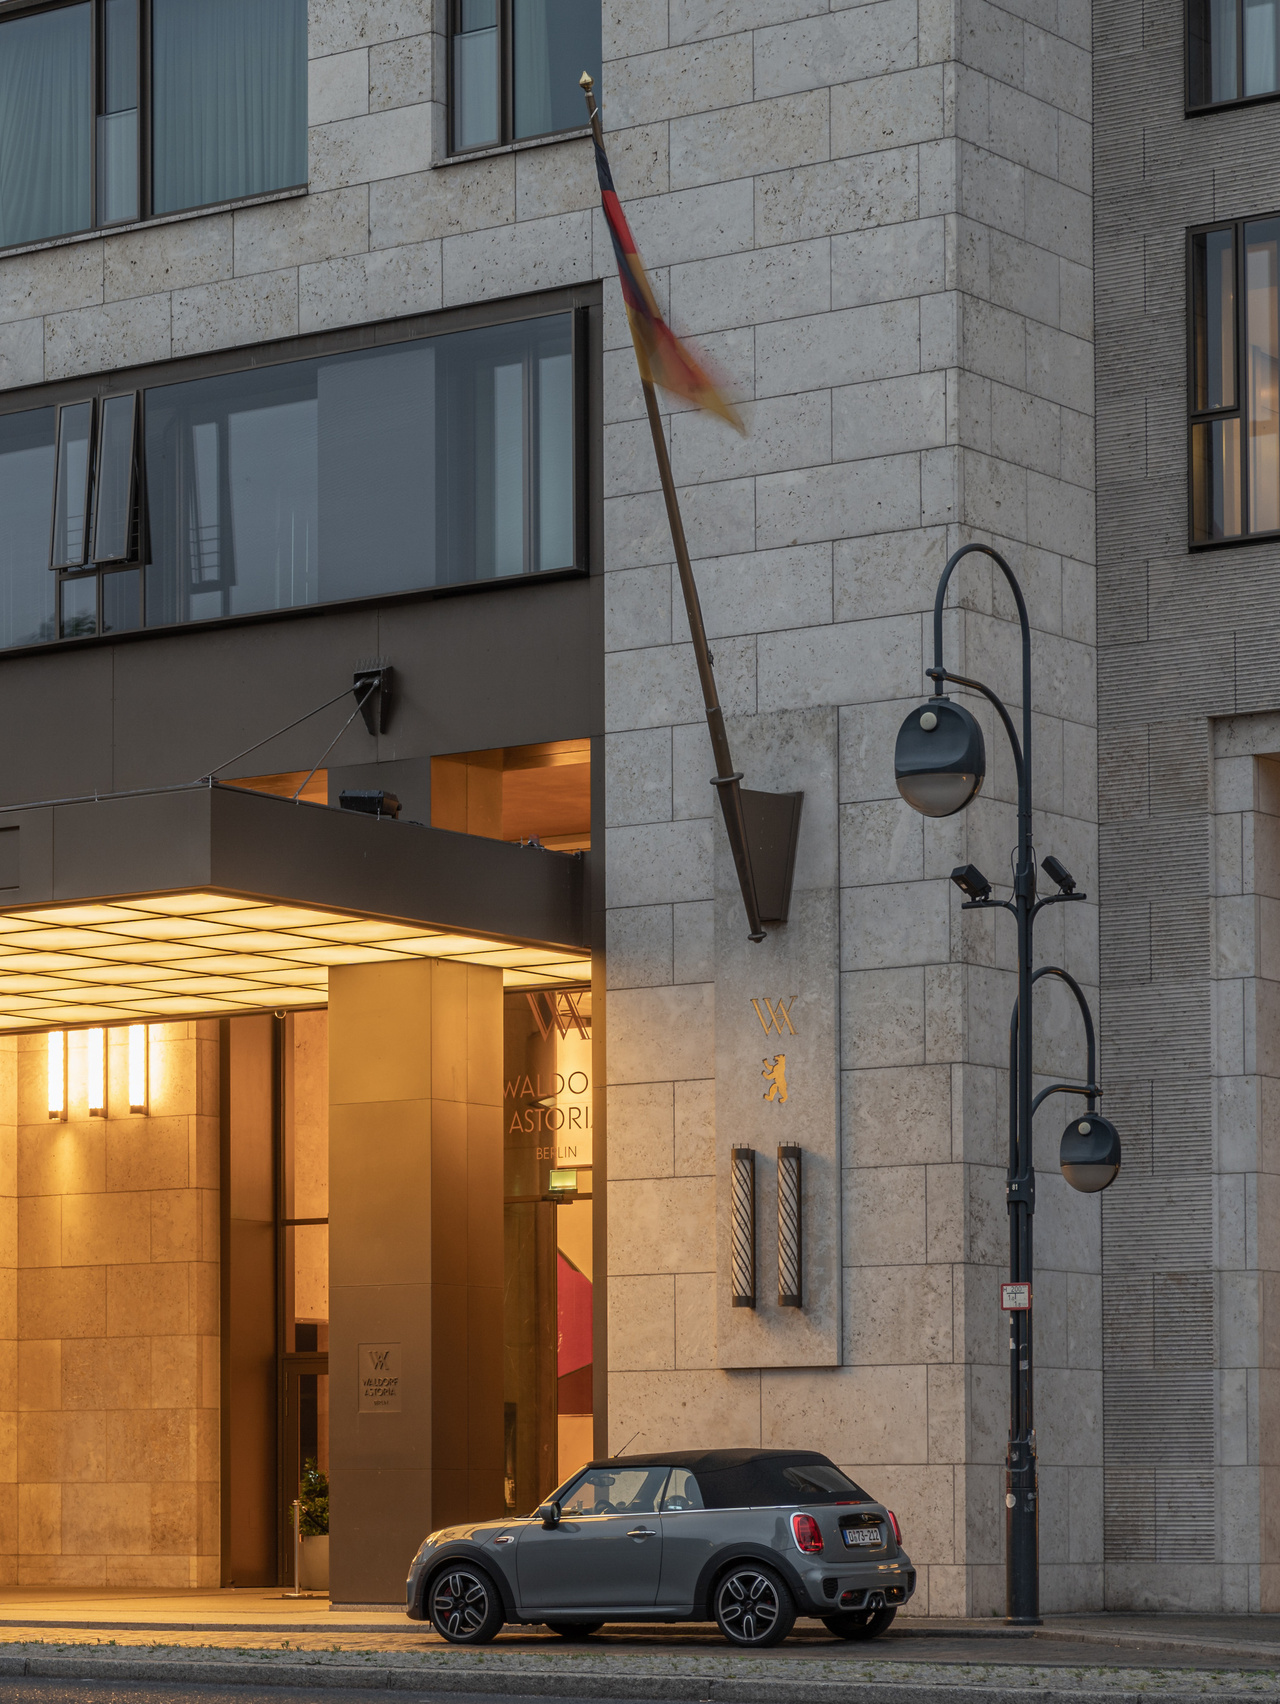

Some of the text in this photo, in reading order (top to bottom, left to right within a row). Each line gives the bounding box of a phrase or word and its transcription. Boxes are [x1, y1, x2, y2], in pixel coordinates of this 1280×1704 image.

[509, 1106, 592, 1134] ASTORI
[536, 1146, 577, 1160] BERLIN
[363, 1377, 399, 1387] WALDORF
[364, 1387, 396, 1397] ASTORIA
